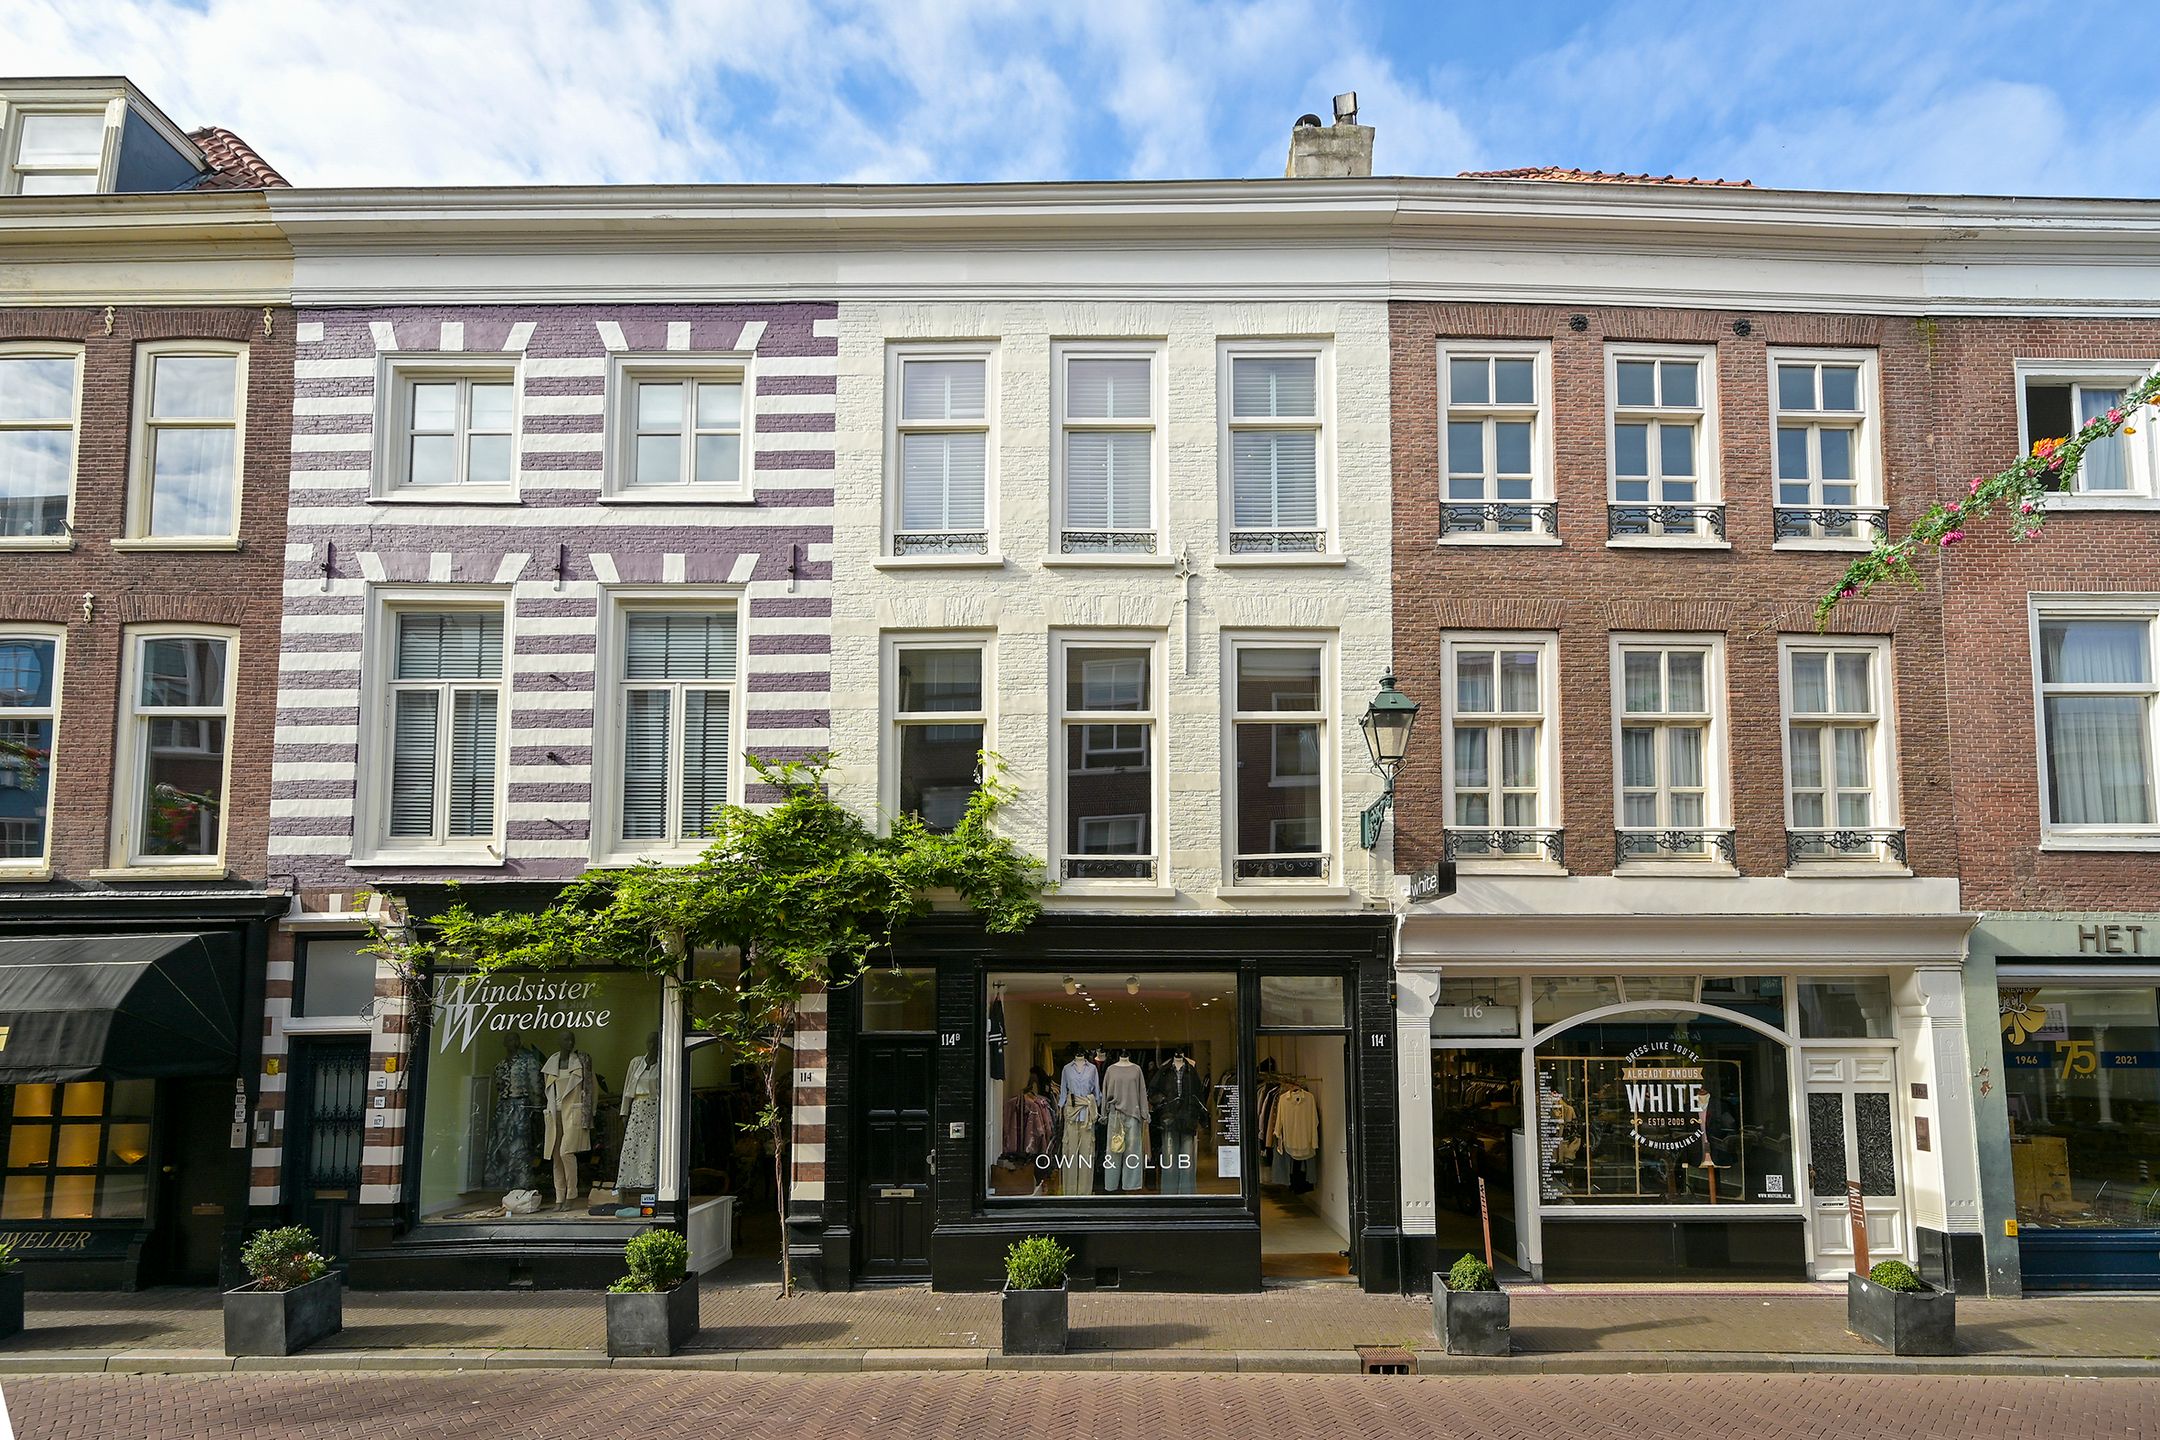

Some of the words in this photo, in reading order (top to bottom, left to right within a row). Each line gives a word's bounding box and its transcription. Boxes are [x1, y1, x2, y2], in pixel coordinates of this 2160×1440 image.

[1411, 874, 1437, 897] white
[2079, 925, 2143, 953] HET
[434, 975, 595, 1024] Windsister
[1463, 1005, 1483, 1018] 116
[440, 1003, 611, 1054] Warehouse
[1625, 1044, 1649, 1063] DRESS
[1651, 1041, 1669, 1051] LIKE
[1673, 1043, 1700, 1063] YOU'RE
[2015, 1056, 2038, 1065] 1946
[2055, 1041, 2097, 1079] 75
[2115, 1056, 2138, 1065] 2021
[1627, 1069, 1662, 1079] ALREADY
[1666, 1069, 1698, 1079] FAMOUS
[1625, 1084, 1704, 1112] WHITE
[1648, 1118, 1665, 1126] ESTD
[1668, 1118, 1685, 1126] 2009
[1629, 1128, 1705, 1151] WWW.WHITEONLINE.NL
[1035, 1154, 1092, 1169] OWN
[1102, 1154, 1117, 1169] &
[1125, 1154, 1191, 1169] CLUB
[1849, 1185, 1865, 1228] WHITE
